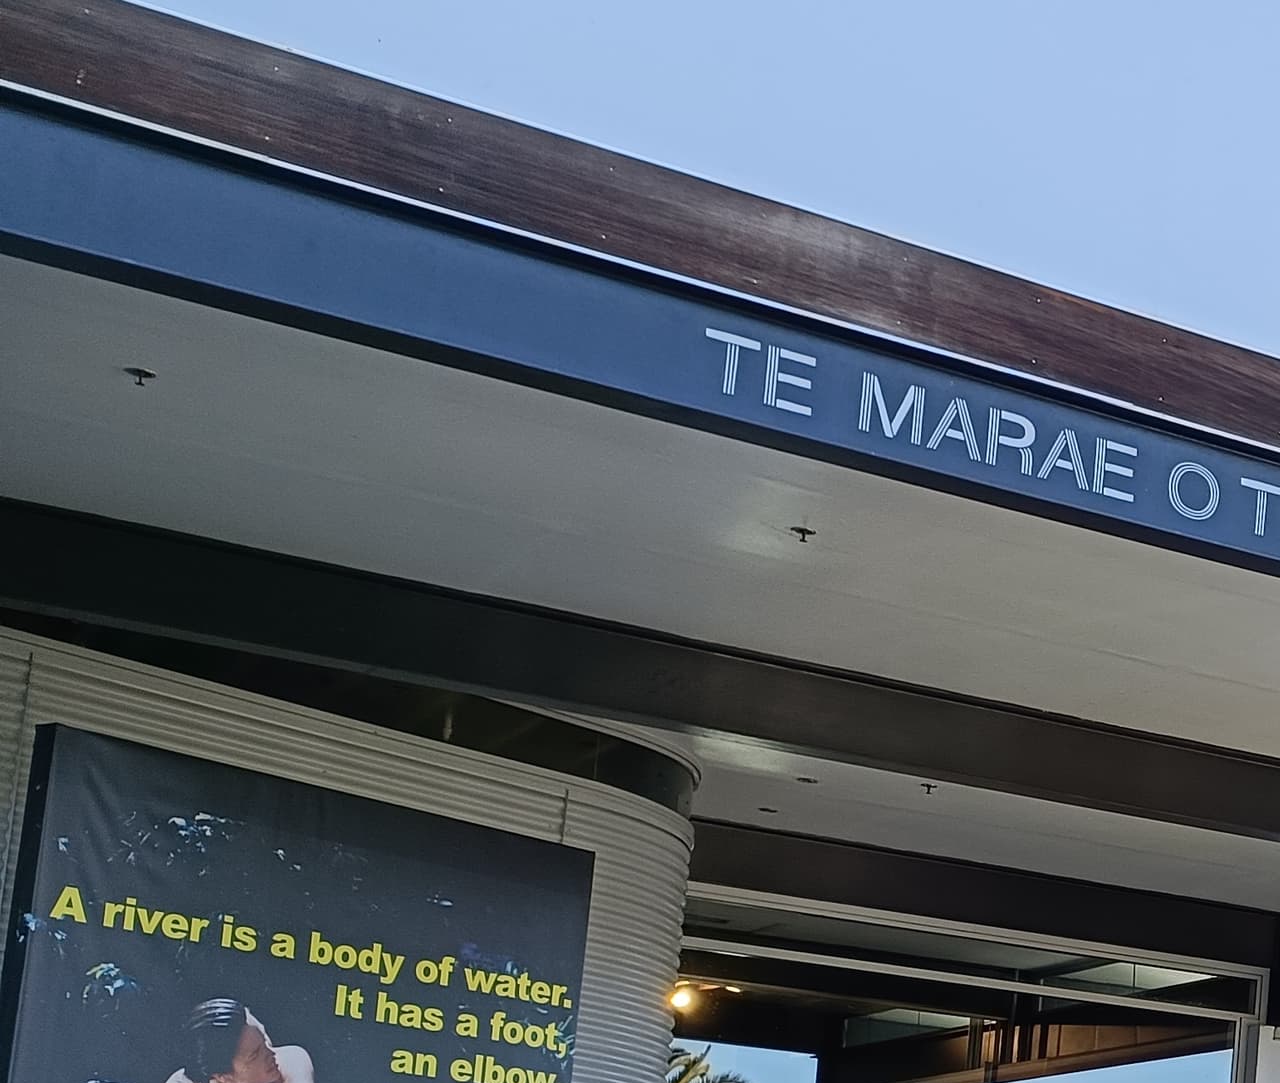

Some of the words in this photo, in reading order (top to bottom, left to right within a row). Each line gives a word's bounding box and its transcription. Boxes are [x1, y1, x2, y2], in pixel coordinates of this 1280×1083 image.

[705, 327, 817, 418] TE
[859, 371, 1139, 503] MARAE
[1167, 461, 1220, 521] O
[51, 885, 87, 923] A
[102, 897, 209, 946] river
[222, 914, 257, 952] is
[270, 931, 295, 960] a
[308, 931, 404, 985] body
[415, 950, 454, 986] of
[465, 967, 573, 1008] water.
[335, 986, 365, 1019] It
[377, 994, 444, 1034] has
[456, 1013, 479, 1039] a
[490, 1010, 568, 1055] foot,
[391, 1050, 438, 1079] an
